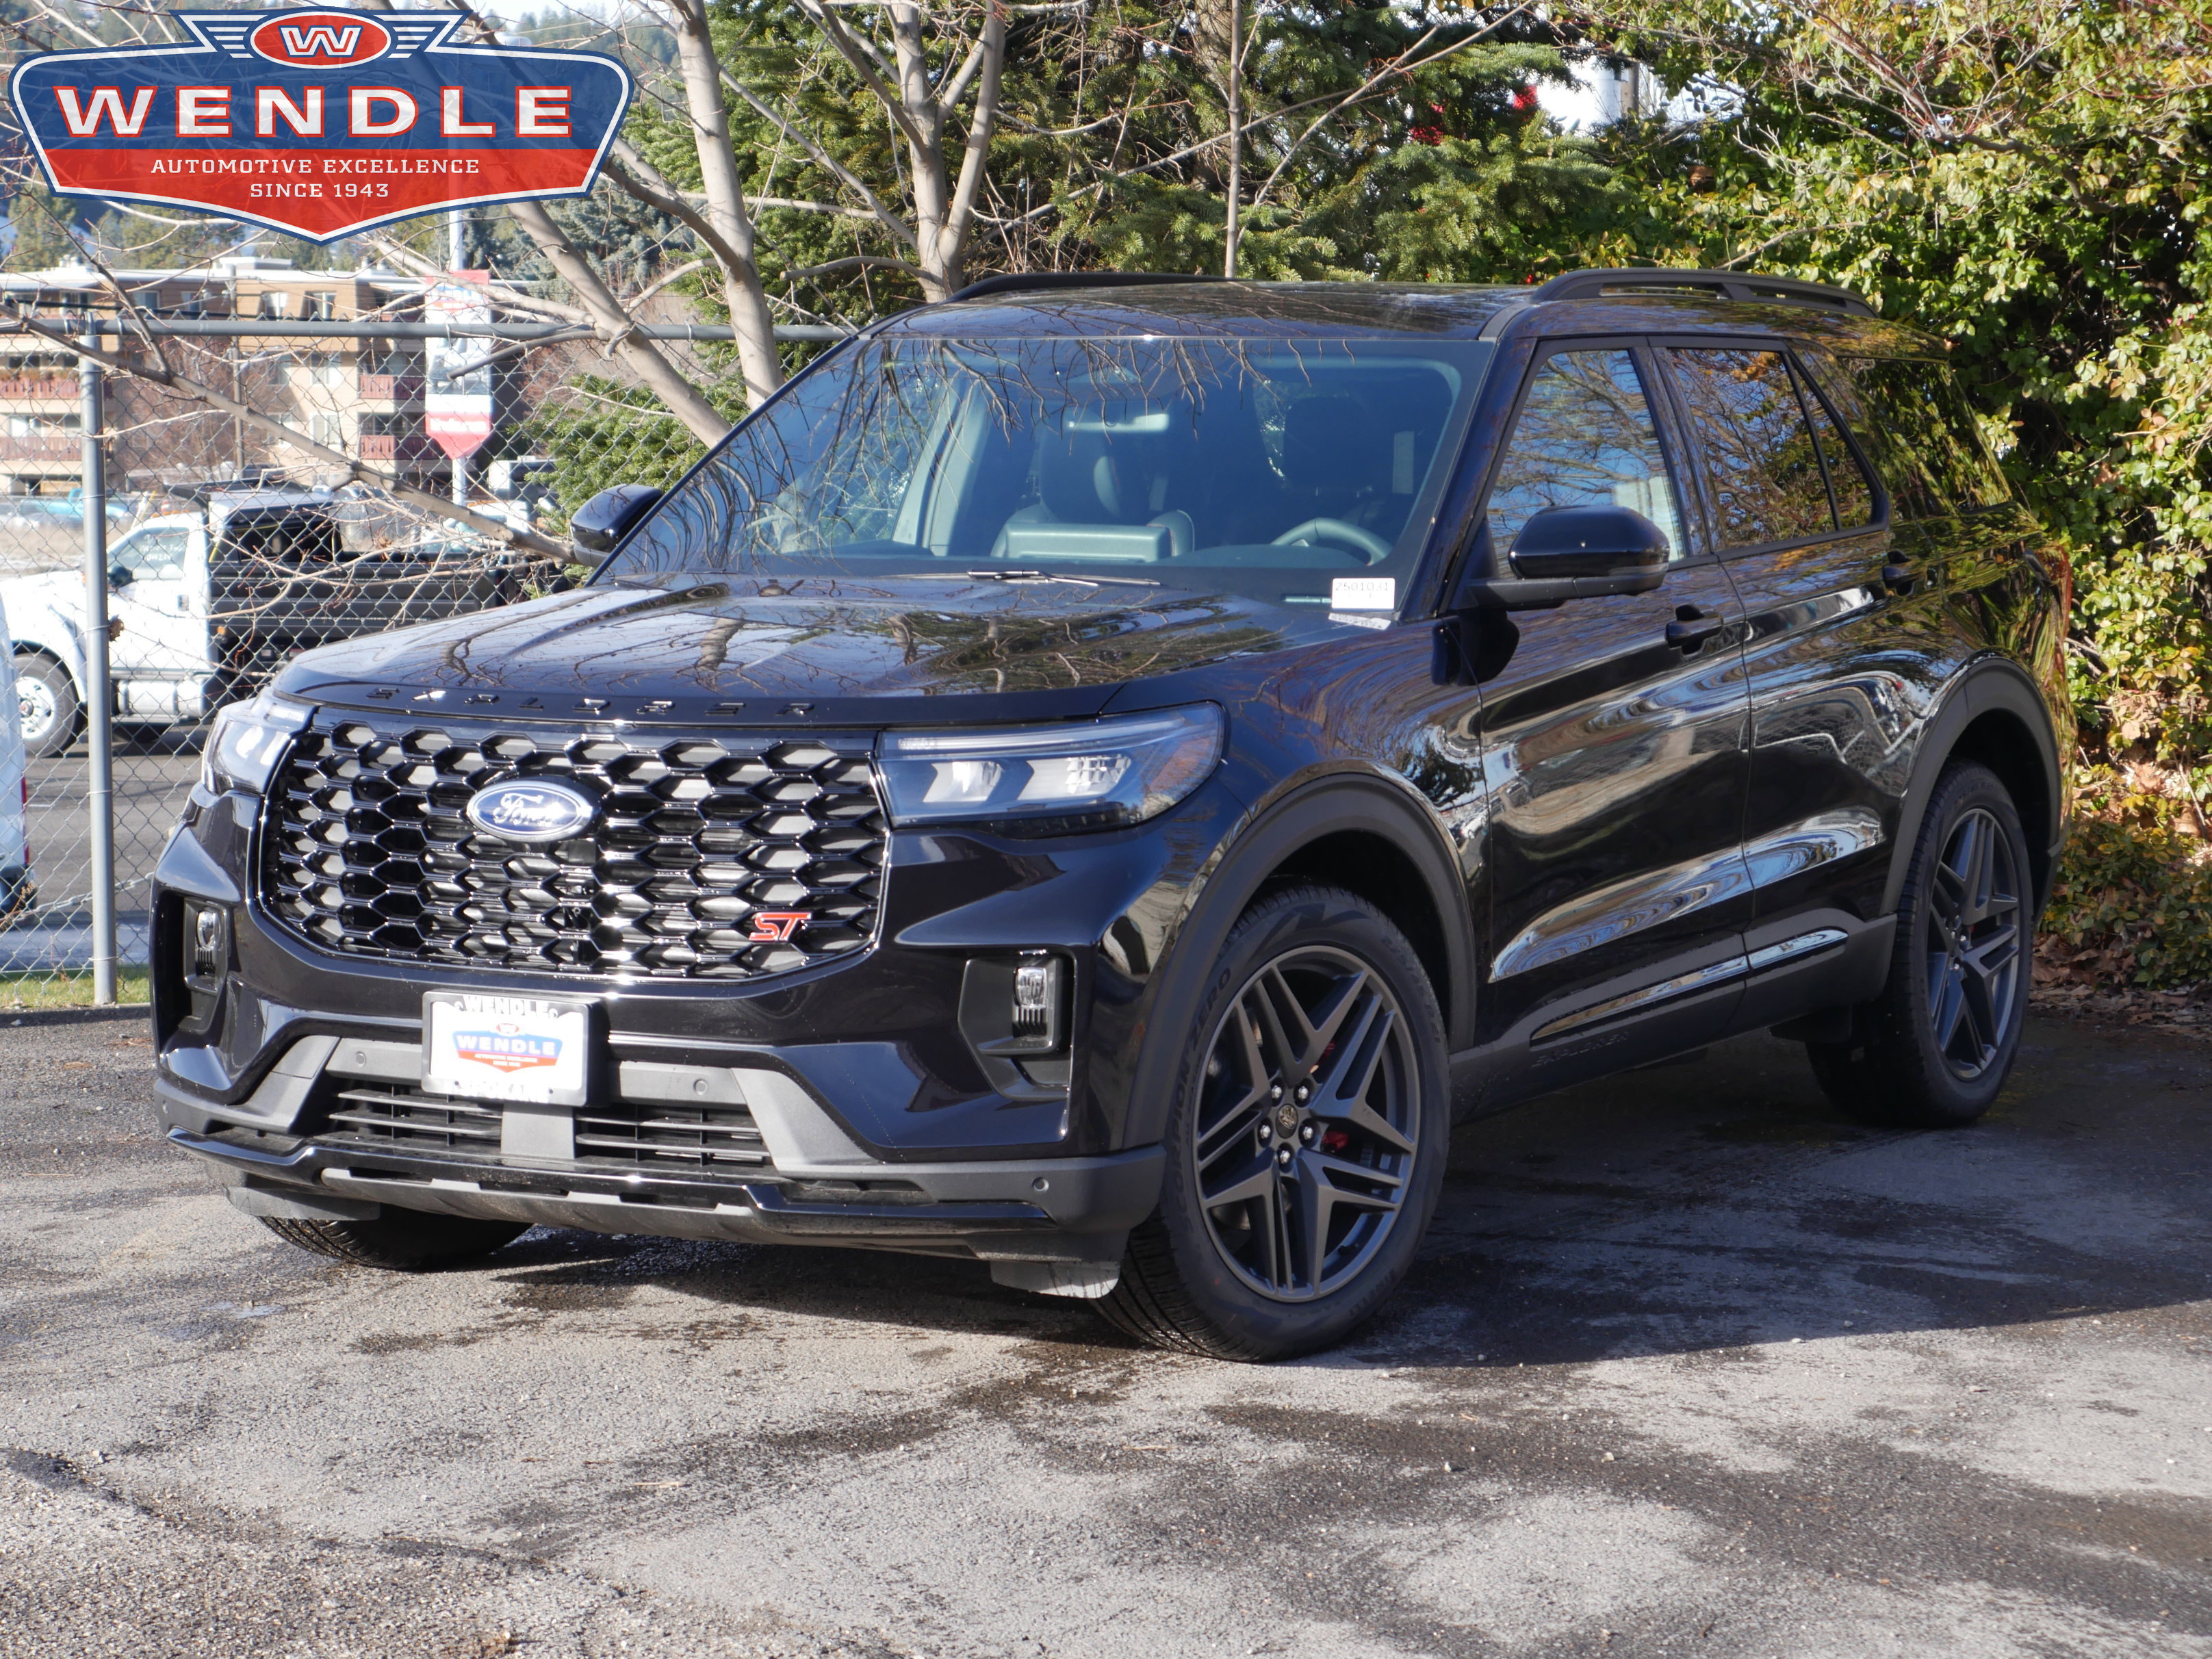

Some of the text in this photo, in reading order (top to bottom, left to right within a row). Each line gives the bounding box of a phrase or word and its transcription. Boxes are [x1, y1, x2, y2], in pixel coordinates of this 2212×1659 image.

[365, 687, 814, 717] EXPLORER
[493, 793, 563, 827] Ford
[749, 912, 811, 941] ST
[462, 995, 549, 1018] WENDLE
[456, 1035, 556, 1056] WENDLE
